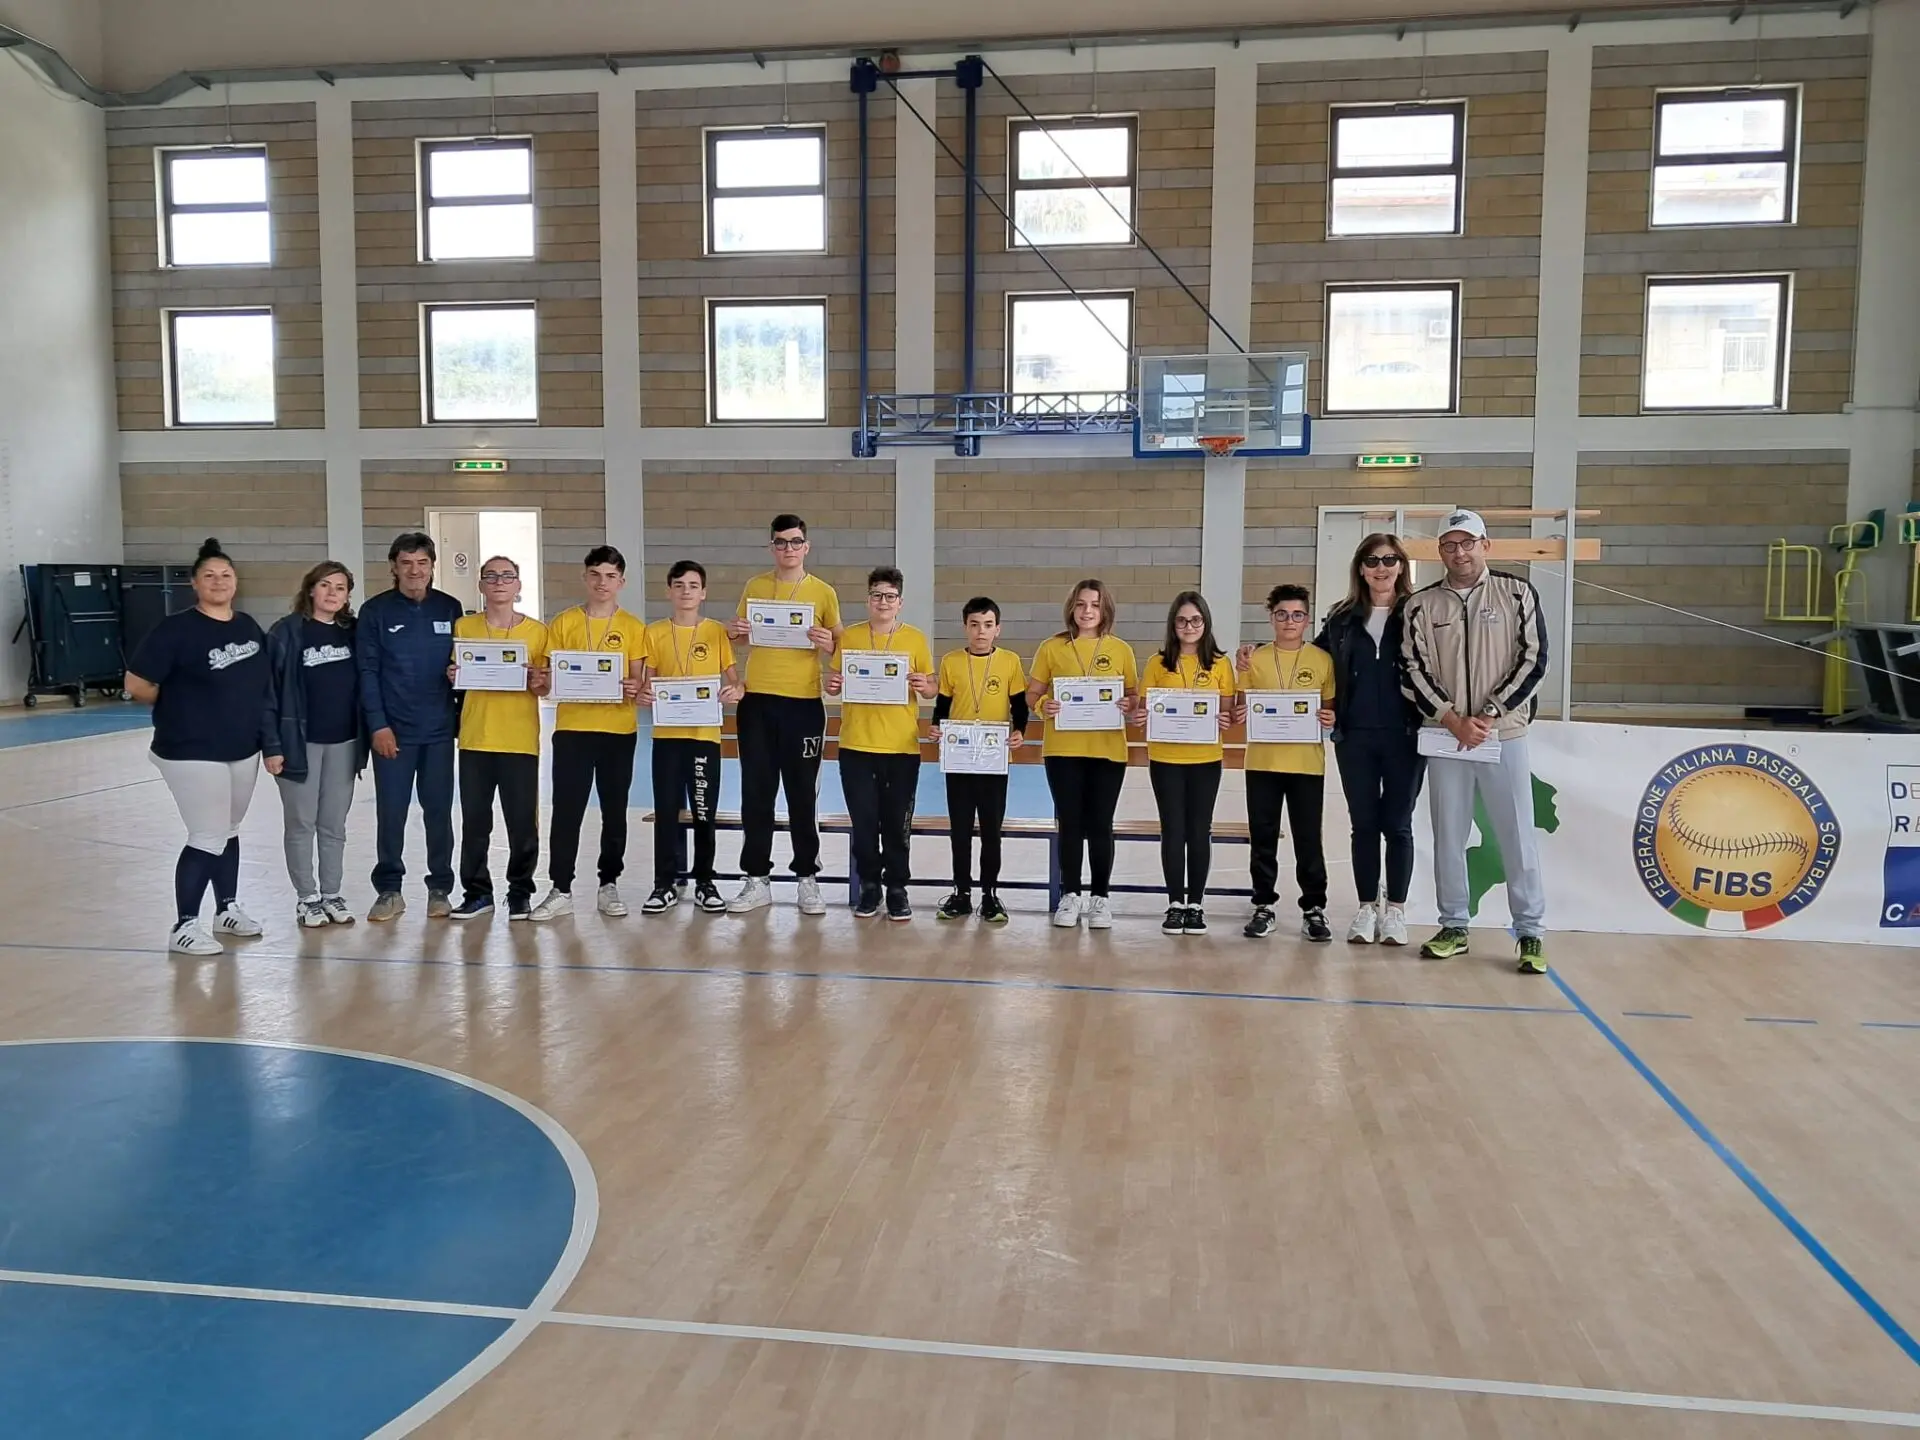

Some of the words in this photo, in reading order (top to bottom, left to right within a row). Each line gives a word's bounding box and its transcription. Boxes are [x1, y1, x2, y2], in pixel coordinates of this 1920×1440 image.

[802, 736, 821, 758] N
[694, 755, 708, 777] Los
[1639, 785, 1671, 898] FEDERAZIONE
[1663, 748, 1736, 784] ITALIANA
[1746, 750, 1823, 814] BASEBALL
[1788, 821, 1837, 905] SOFTBALL
[1692, 866, 1772, 897] FIBS
